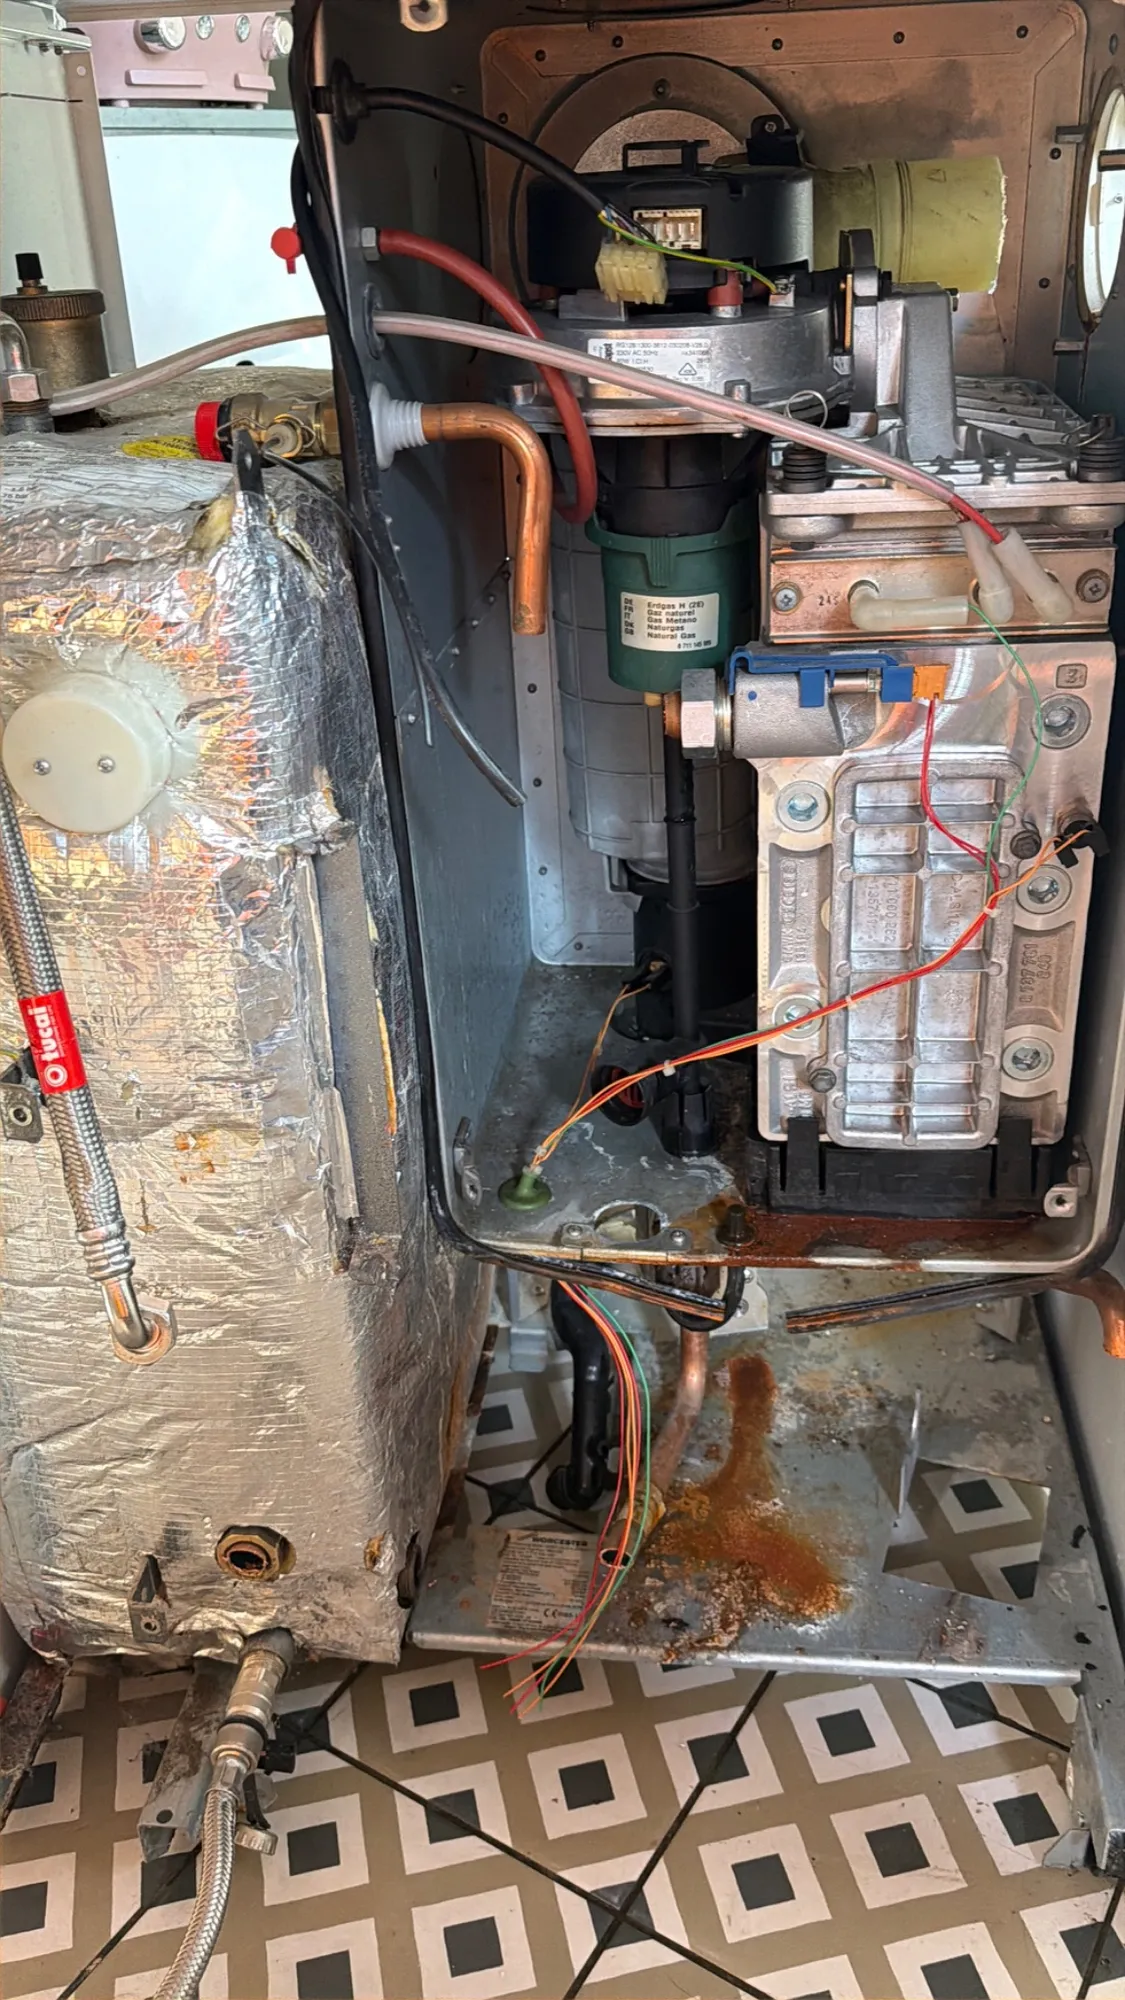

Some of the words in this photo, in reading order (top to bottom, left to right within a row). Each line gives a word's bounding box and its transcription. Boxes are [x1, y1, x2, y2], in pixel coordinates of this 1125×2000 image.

[689, 601, 704, 609] (2E)
[28, 1006, 60, 1061] tucai
[532, 1536, 588, 1546] WORCESTER
